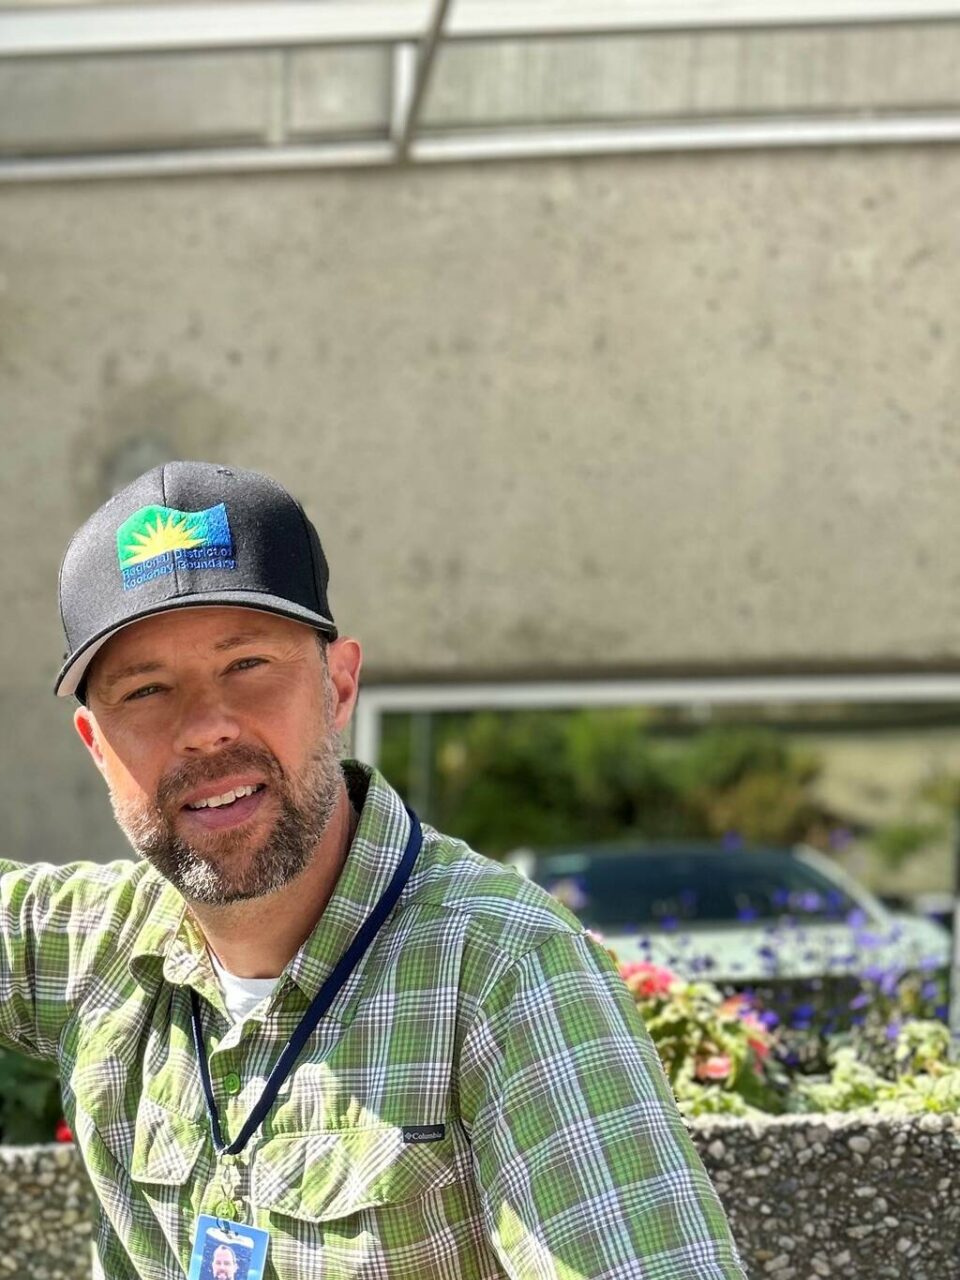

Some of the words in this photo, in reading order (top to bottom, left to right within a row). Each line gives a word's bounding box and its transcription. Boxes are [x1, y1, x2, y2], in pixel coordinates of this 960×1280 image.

[122, 552, 170, 580] Regional
[123, 564, 174, 590] Kootenay
[176, 559, 237, 571] Boundary
